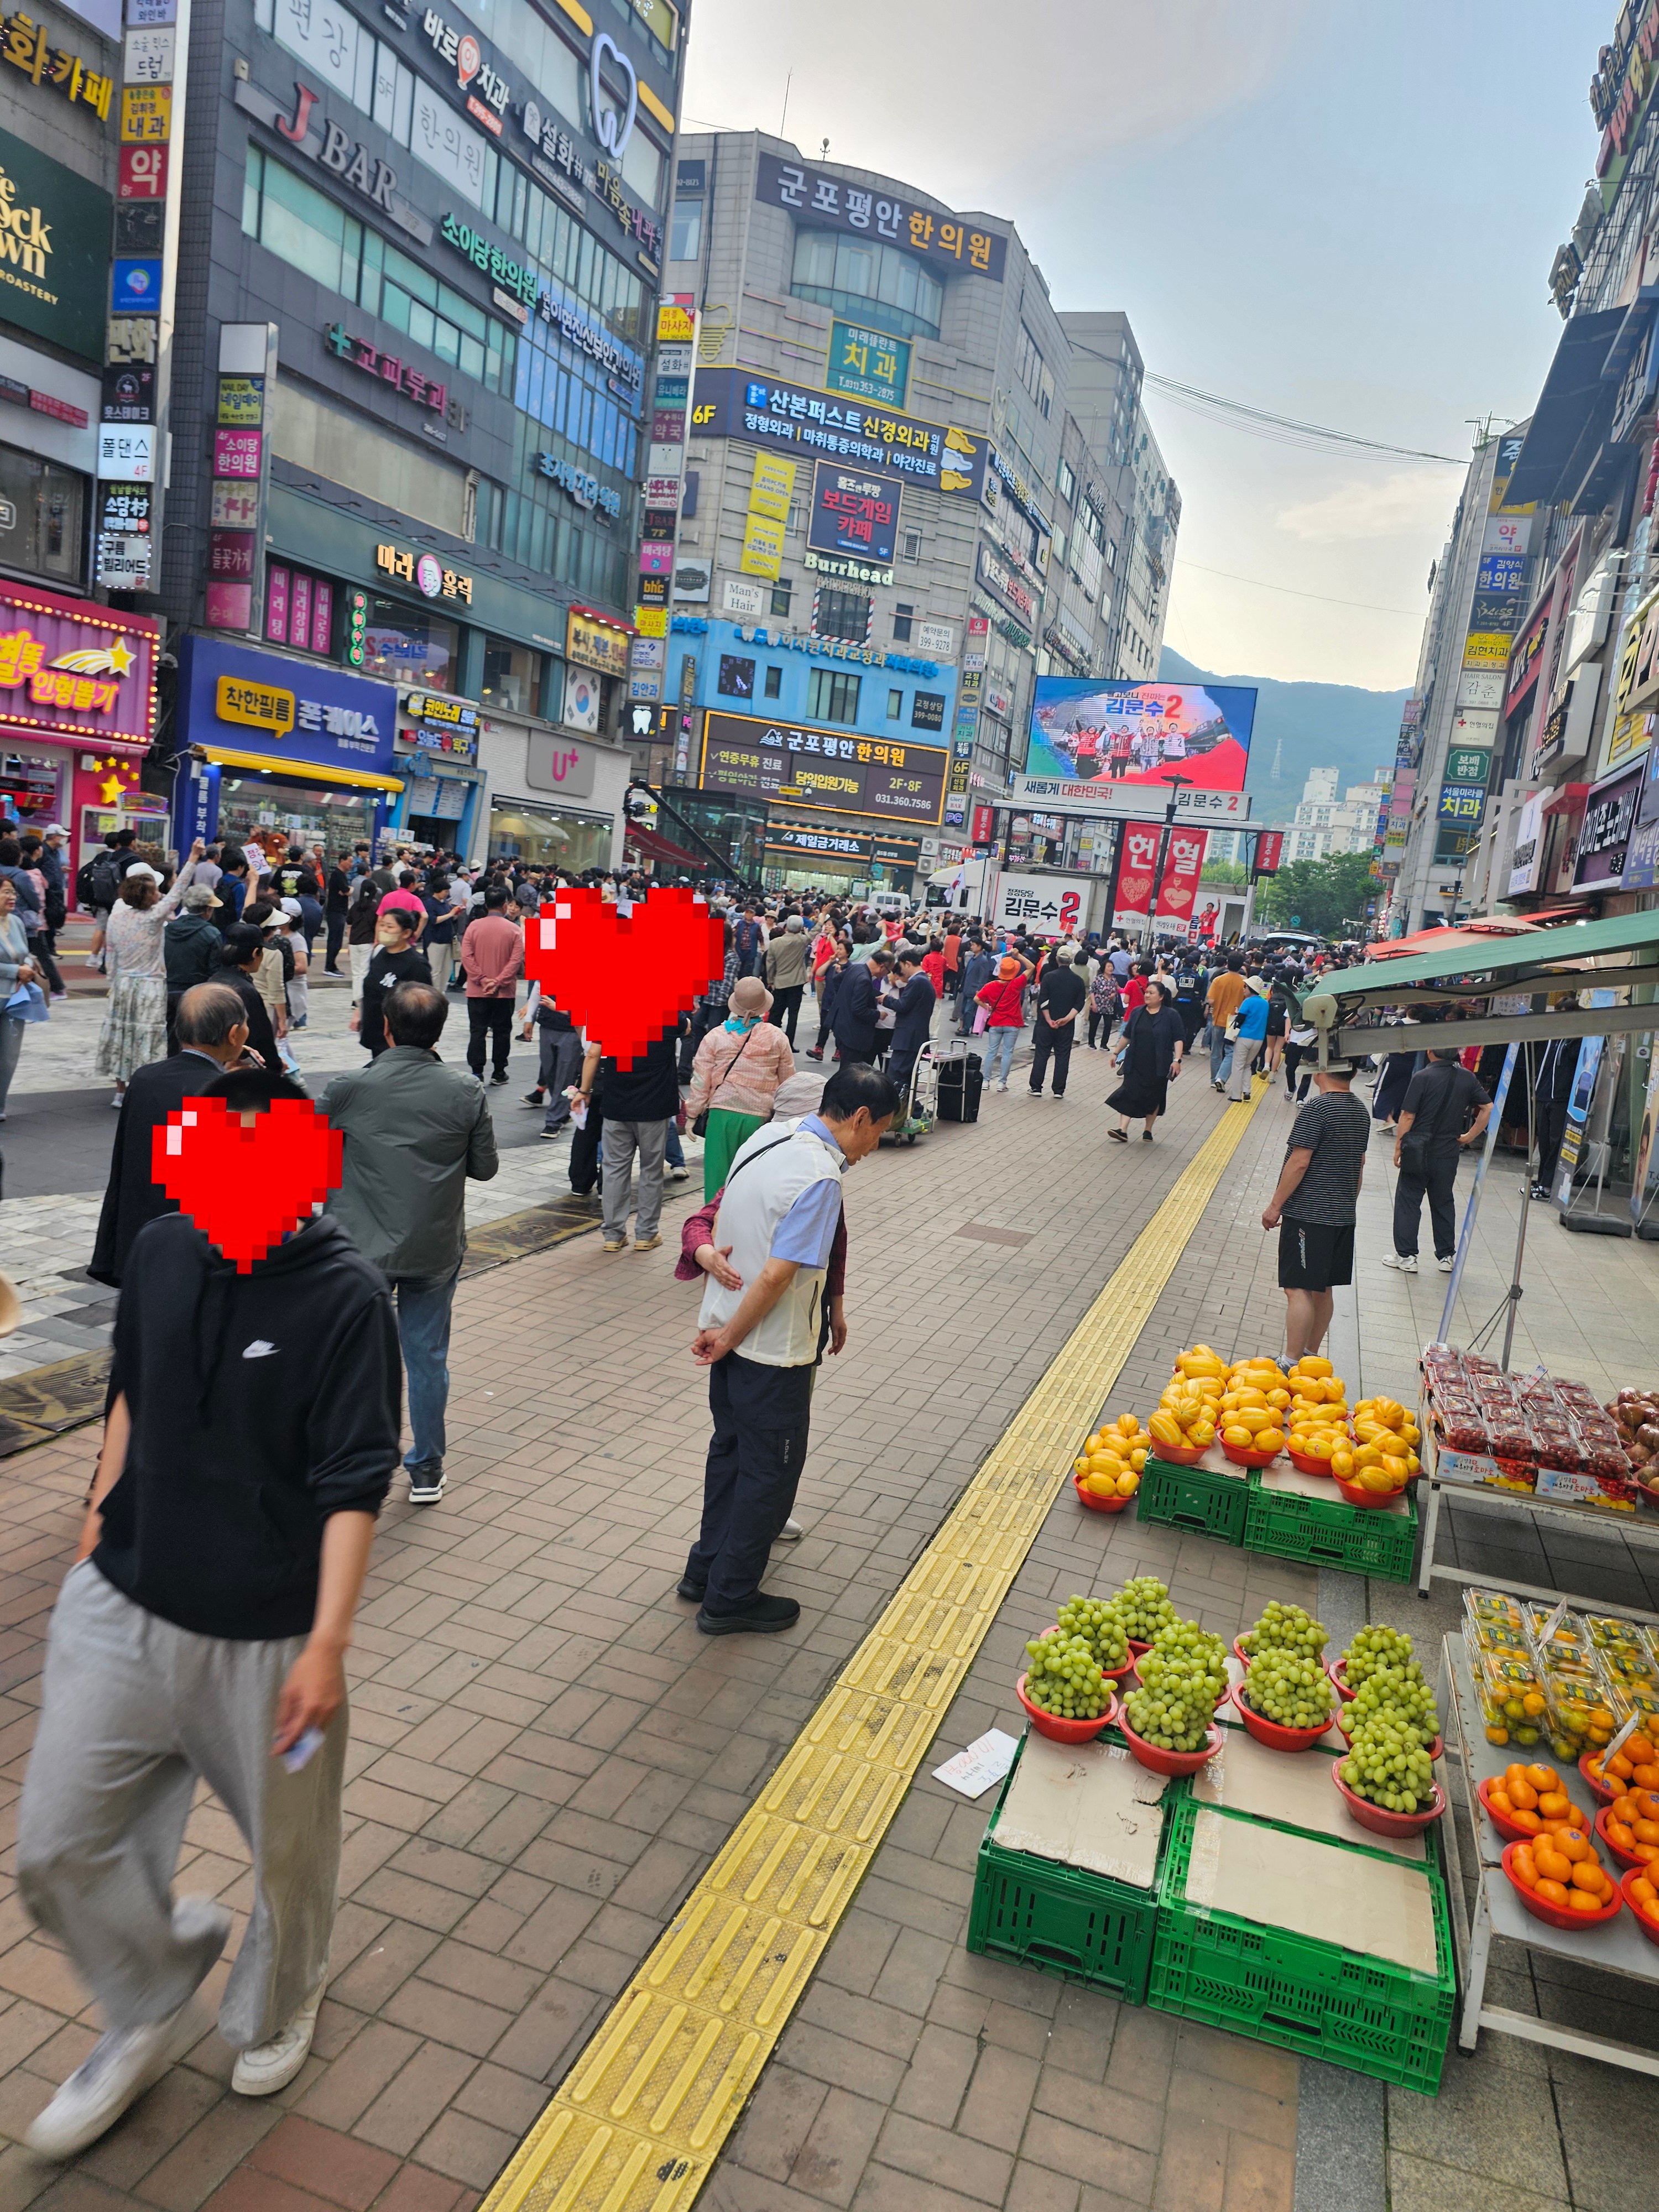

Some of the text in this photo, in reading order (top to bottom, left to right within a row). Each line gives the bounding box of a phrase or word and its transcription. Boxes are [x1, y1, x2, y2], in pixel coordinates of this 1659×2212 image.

[0, 12, 113, 122] 화카페
[128, 116, 165, 138] 내과
[274, 82, 398, 213] J BAR
[131, 150, 161, 195] 약
[778, 166, 992, 271] 군포평안 한의원
[442, 213, 538, 310] 소이당한의원
[660, 320, 692, 332] 마사지
[848, 327, 897, 352] 미래플란트
[661, 359, 682, 372] 설화
[843, 342, 898, 383] 치과
[692, 405, 717, 424] 6F
[769, 389, 862, 434] 산본퍼스트
[863, 415, 931, 453] 신경외과
[655, 424, 682, 440] 약국
[102, 439, 149, 458] 폴댄스
[226, 438, 258, 452] 소이당
[744, 412, 937, 476] 정형외과 마취통증의학과 야간진료
[134, 465, 148, 477] 4F
[218, 453, 257, 473] 한의원
[821, 489, 891, 525] 보드게임
[837, 516, 872, 542] 카페
[1499, 524, 1517, 545] 약
[105, 541, 125, 555] 구름
[104, 557, 146, 573] 빌리어드
[378, 544, 472, 604] 마라 홀릭
[805, 552, 894, 585] Burrhead
[644, 579, 664, 593] bhc
[1478, 570, 1521, 590] 한의원
[729, 583, 759, 598] Man's
[731, 598, 755, 612] Hair
[922, 625, 950, 637] 예약문의
[920, 637, 950, 651] 399-9278
[1468, 646, 1509, 657] 김현치과
[33, 674, 118, 713] 인형뽑기
[632, 682, 658, 697] 김안과
[226, 686, 290, 722] 착한필름
[1105, 695, 1183, 718] 김문수 2
[299, 699, 380, 743] 폰케이스
[787, 731, 906, 768] 군포평안 한의원
[719, 750, 782, 771] 연중무휴 진료
[953, 761, 969, 774] 6F
[1458, 755, 1480, 766] 보배
[1457, 765, 1478, 777] 반점
[795, 770, 859, 794] 당일입원가능
[875, 793, 932, 811] 031.360.7586
[1024, 780, 1239, 811] 새롭게 대한민국! 김문수 2
[945, 812, 963, 824] PC
[1440, 798, 1481, 819] 치과
[795, 833, 860, 853] 제일금거래소
[979, 831, 985, 840] 2
[1128, 834, 1154, 870] 헌
[1172, 839, 1199, 875] 혈
[1263, 857, 1270, 867] 2
[1007, 888, 1034, 898] 정정당당
[1005, 891, 1081, 924] 김문수 2
[1177, 924, 1186, 932] 3F
